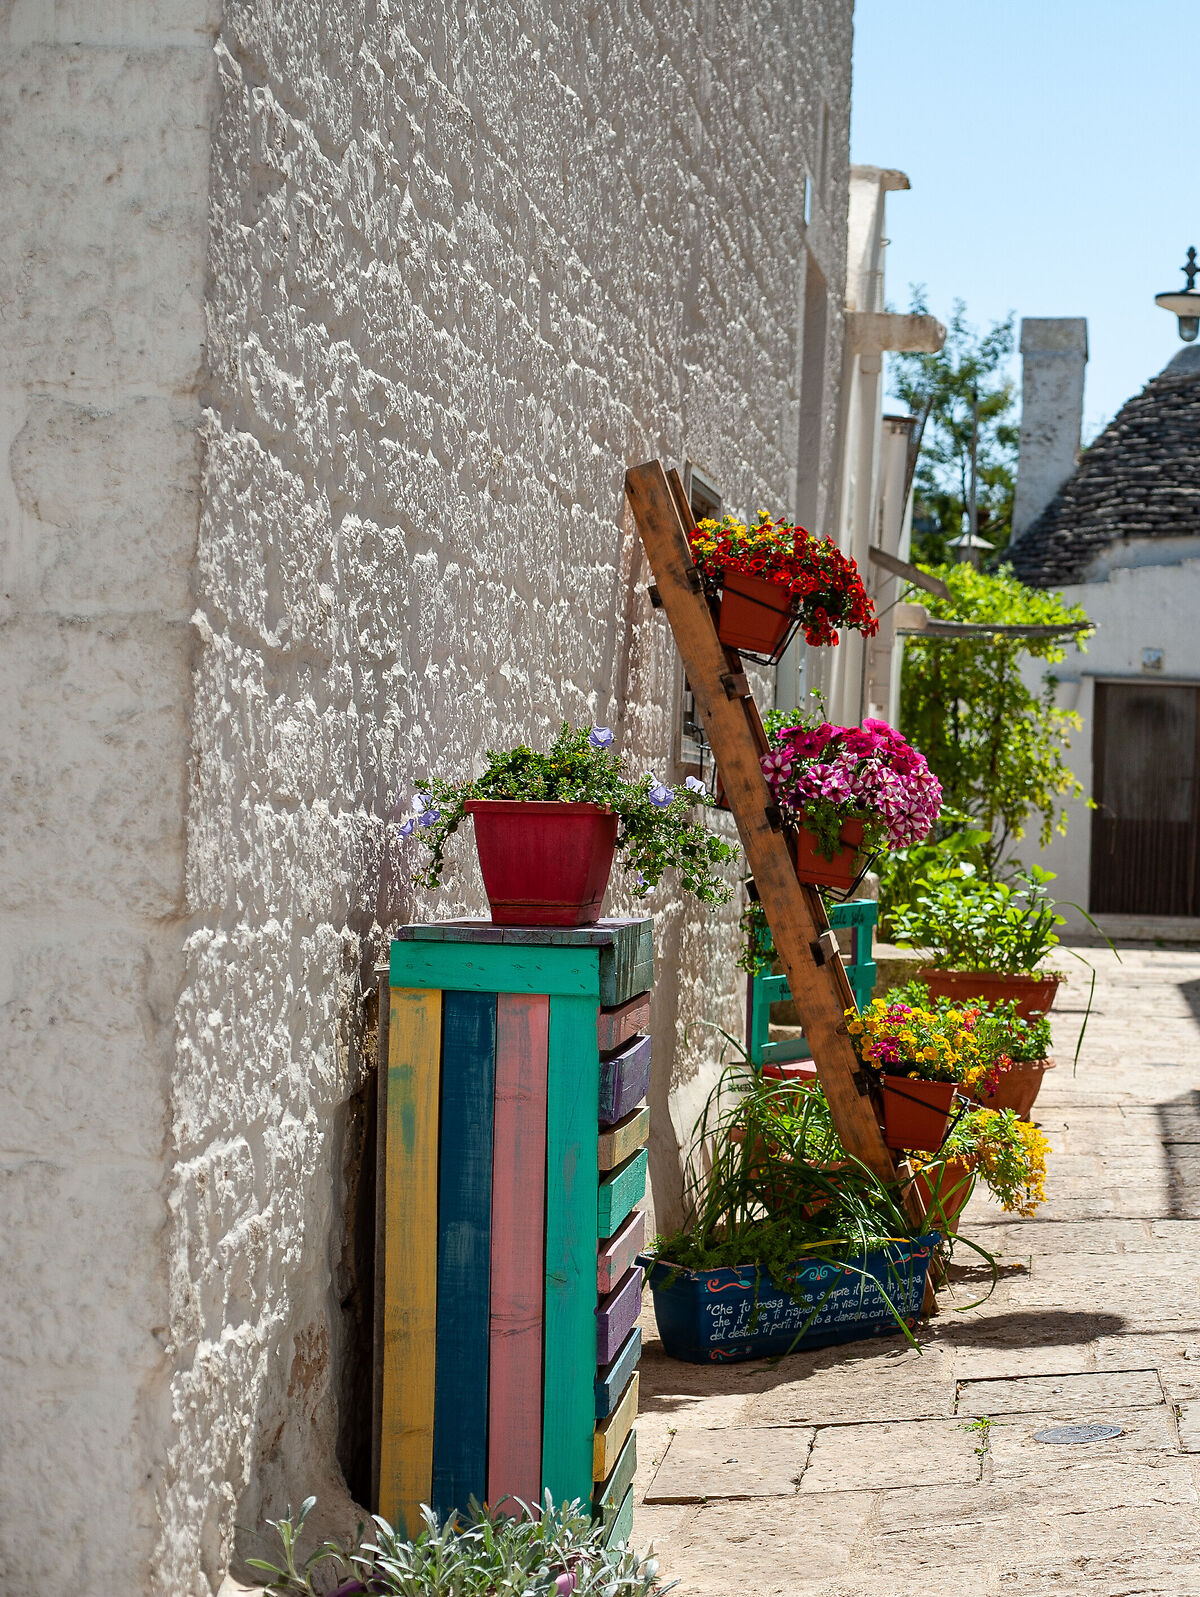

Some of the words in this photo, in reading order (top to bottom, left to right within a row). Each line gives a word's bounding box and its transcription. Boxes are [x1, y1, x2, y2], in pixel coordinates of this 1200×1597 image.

[712, 1315, 731, 1328] che
[736, 1313, 744, 1325] il
[773, 1307, 781, 1320] ti
[830, 1302, 839, 1310] in
[841, 1299, 859, 1309] viso
[862, 1297, 869, 1305] e
[739, 1299, 751, 1314] tu
[852, 1282, 860, 1296] il
[709, 1326, 726, 1341] del
[762, 1321, 770, 1334] ti
[769, 1316, 792, 1336] porti
[793, 1320, 803, 1329] in
[824, 1315, 832, 1324] a
[869, 1308, 884, 1319] con
